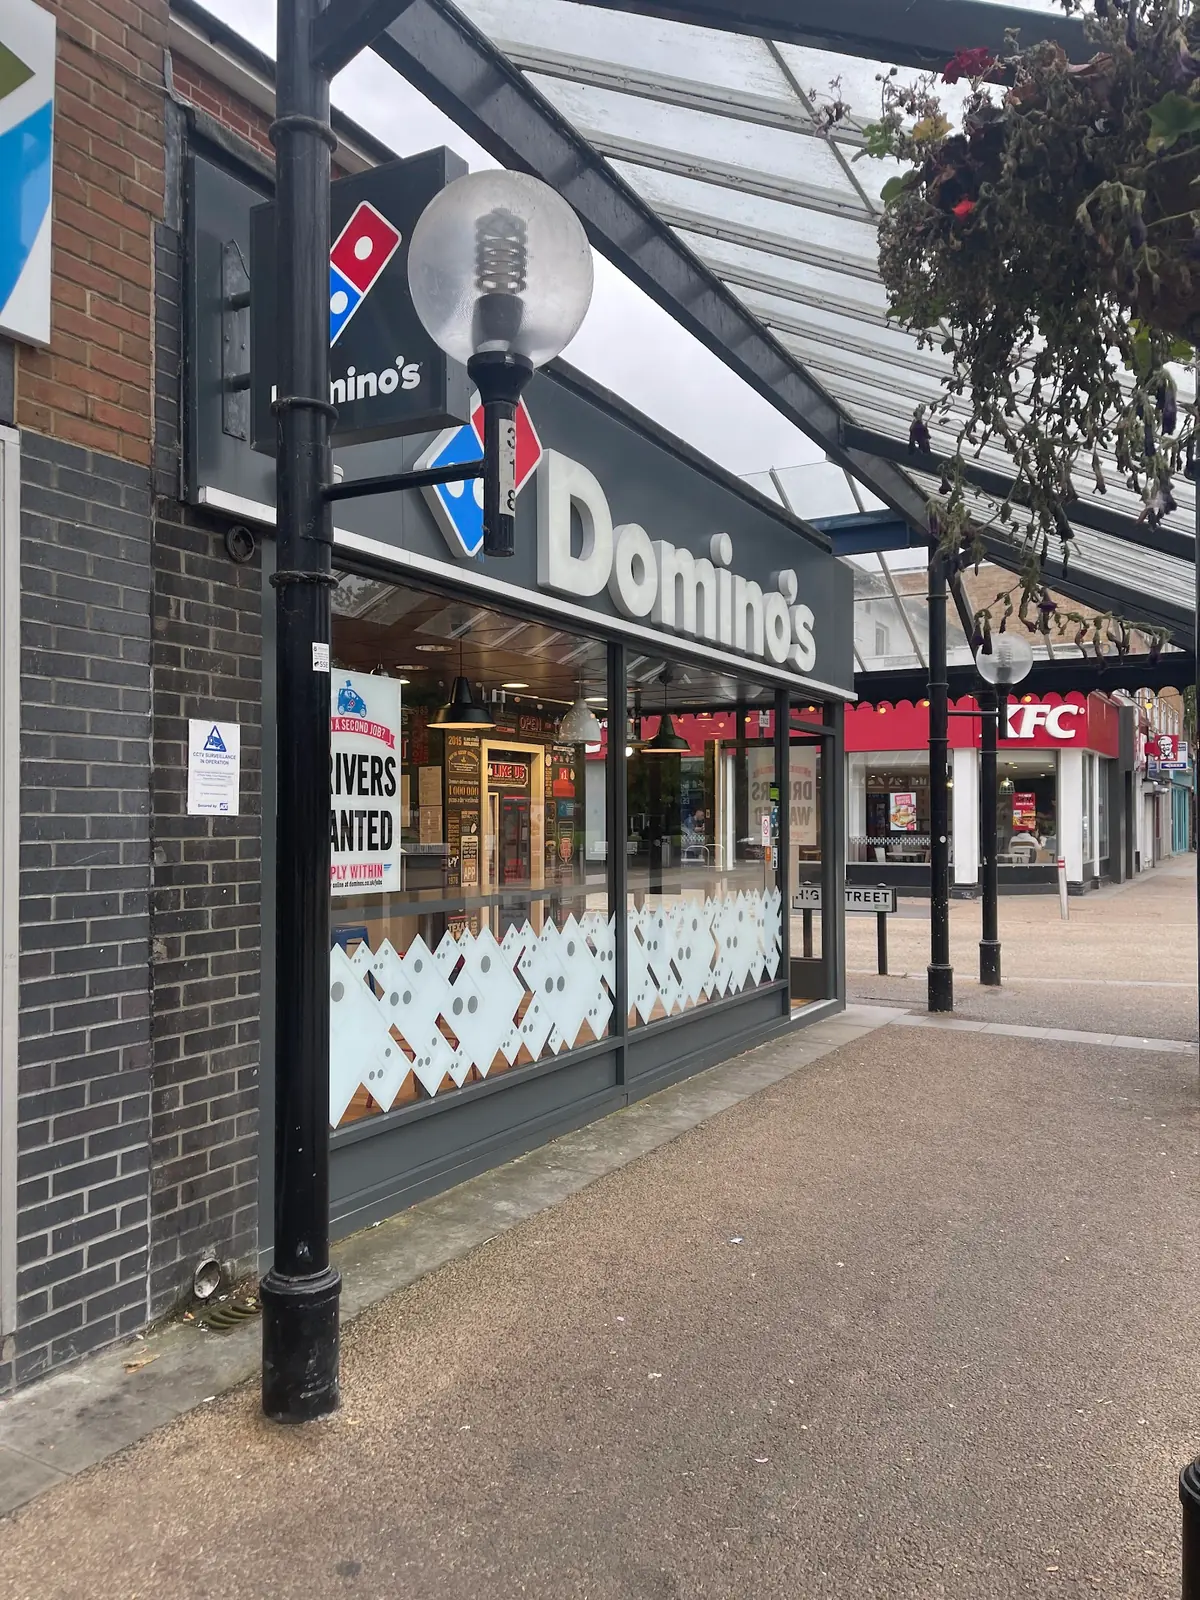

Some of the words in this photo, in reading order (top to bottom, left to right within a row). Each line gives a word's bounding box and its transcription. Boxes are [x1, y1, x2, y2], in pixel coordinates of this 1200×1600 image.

[537, 447, 817, 673] Domino's
[341, 719, 369, 733] SECOND
[369, 723, 386, 739] JOB?
[330, 752, 397, 797] IVERS
[493, 764, 512, 777] LIKE
[514, 766, 525, 779] US
[330, 809, 393, 852] ANTED
[329, 865, 348, 880] PLY
[350, 864, 383, 879] WITHIN
[845, 891, 890, 903] TREET
